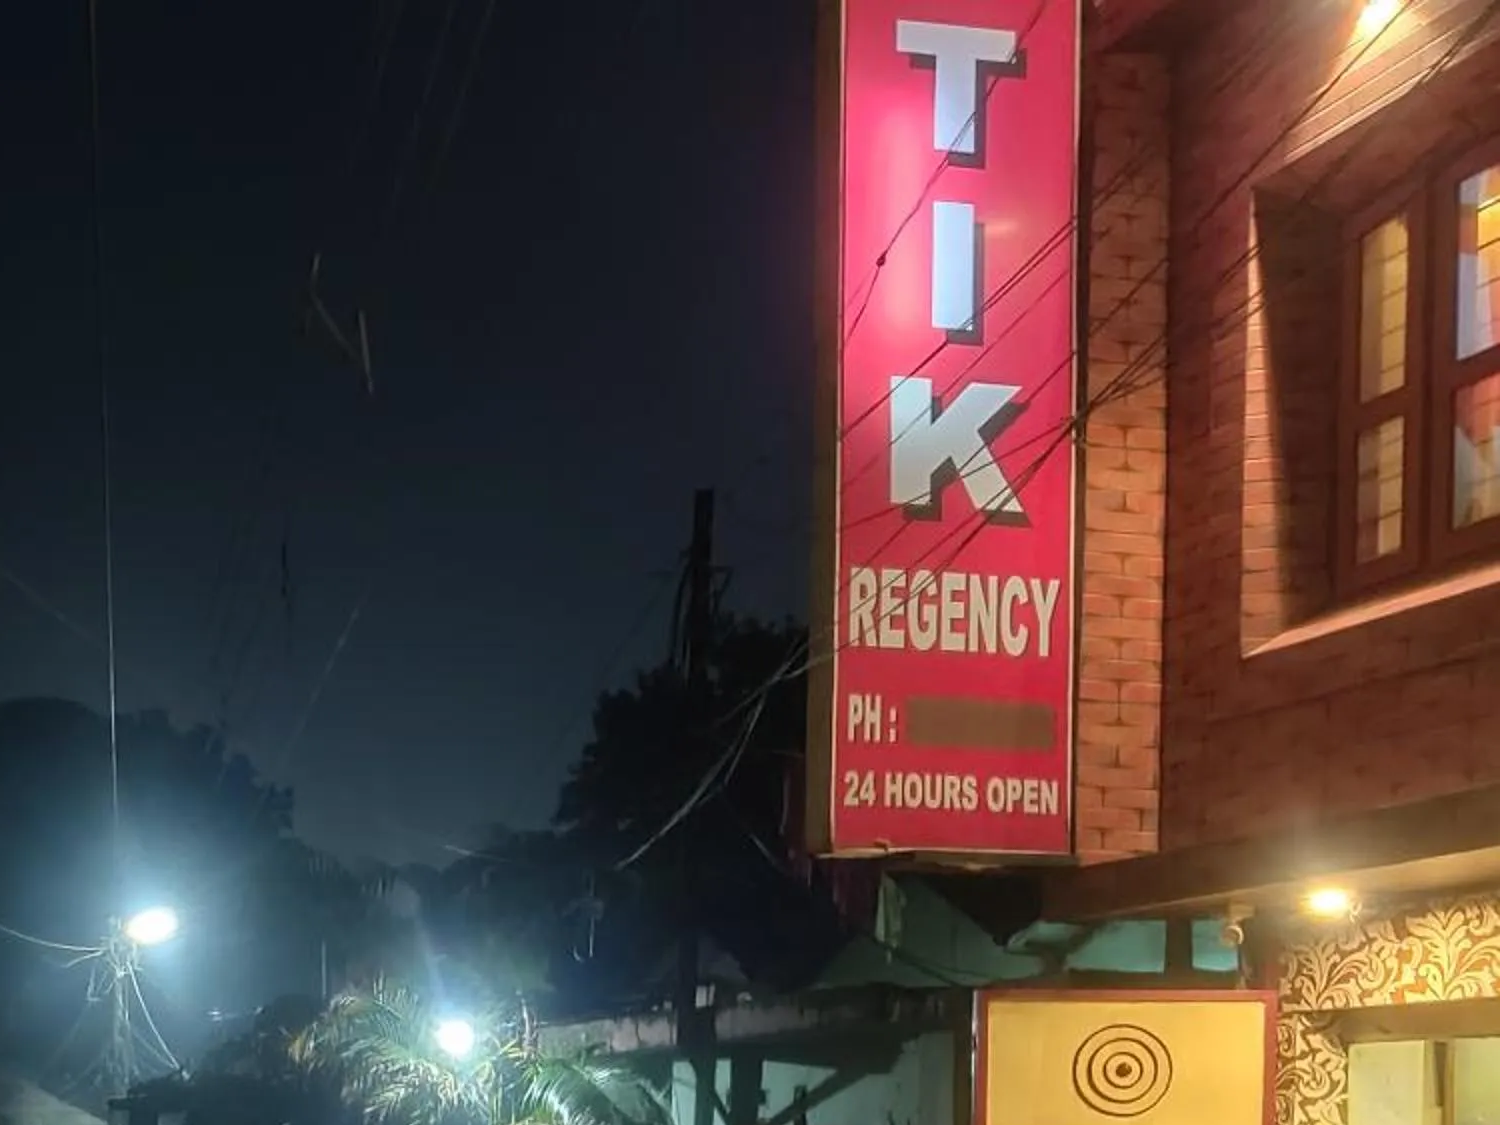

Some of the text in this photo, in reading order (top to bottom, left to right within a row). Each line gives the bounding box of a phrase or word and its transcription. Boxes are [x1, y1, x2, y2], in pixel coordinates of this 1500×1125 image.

[890, 19, 1025, 514] TIK
[850, 567, 1060, 657] REGENCY
[844, 770, 1058, 815] 24 HOURS OPEN
